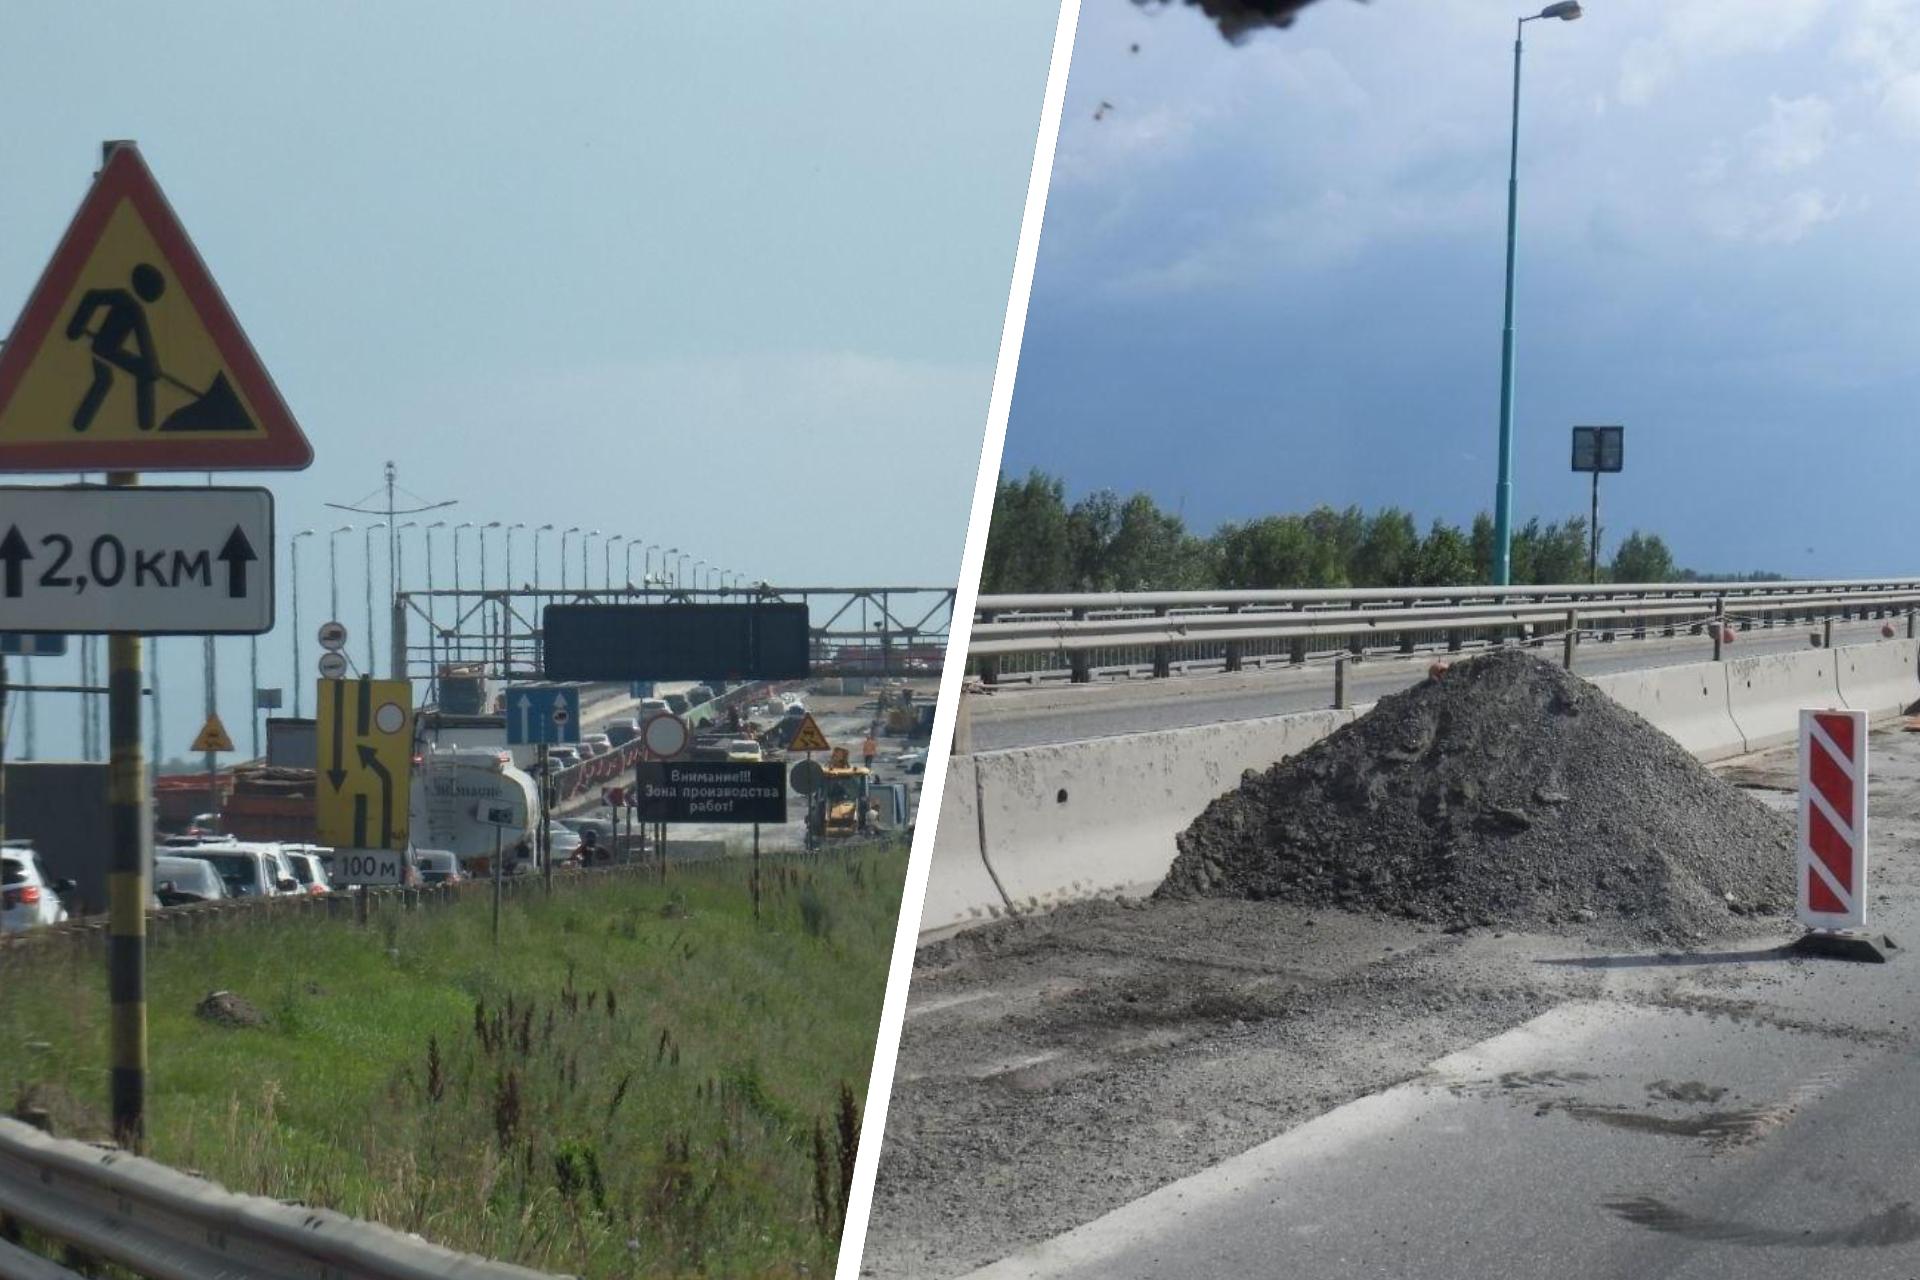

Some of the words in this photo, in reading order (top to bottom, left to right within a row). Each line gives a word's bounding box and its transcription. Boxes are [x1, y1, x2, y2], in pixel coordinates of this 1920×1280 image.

[40, 534, 126, 594] 2,0
[135, 549, 213, 587] км
[671, 769, 751, 783] Внимание!!!
[645, 785, 677, 798] Зона
[682, 787, 779, 799] производства
[689, 801, 734, 814] работ!
[342, 856, 376, 877] 100
